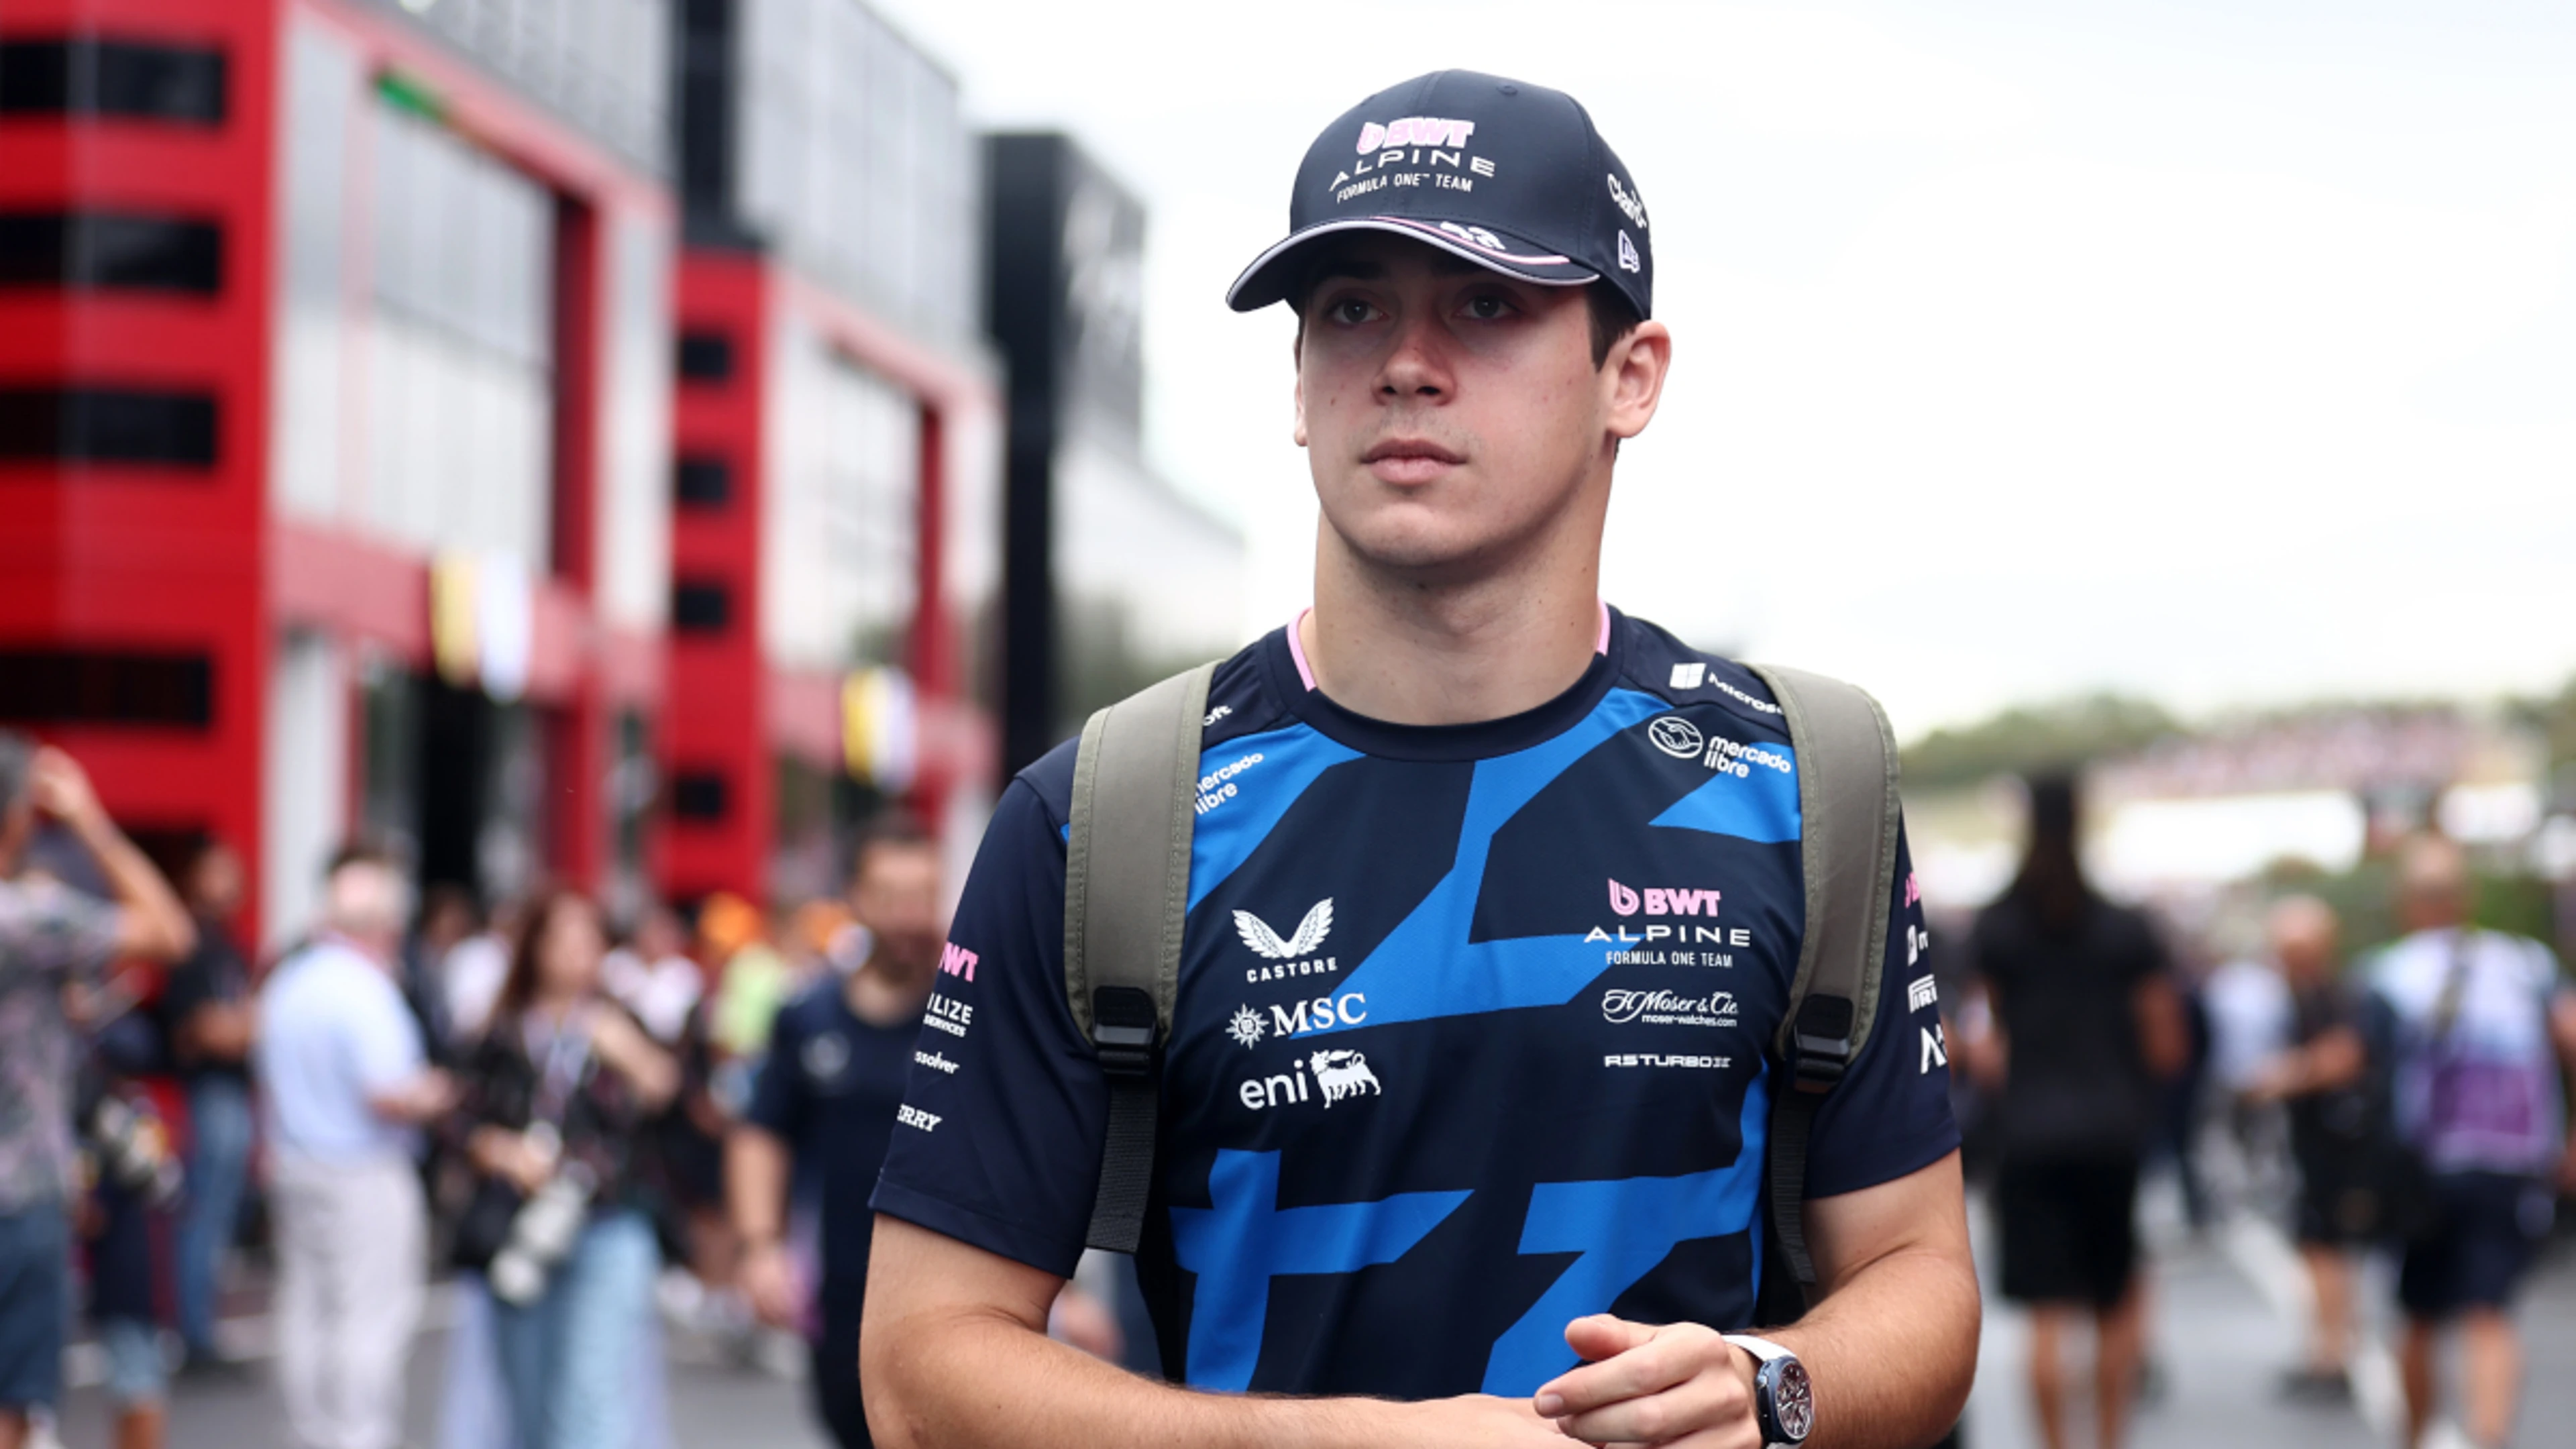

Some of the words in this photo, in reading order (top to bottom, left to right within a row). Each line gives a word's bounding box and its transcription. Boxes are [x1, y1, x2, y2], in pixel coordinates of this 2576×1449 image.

[1382, 117, 1475, 149] BWT
[1328, 148, 1496, 193] ALPINE
[1336, 174, 1388, 205] FORMULA
[1434, 173, 1474, 193] TEAM
[1703, 749, 1751, 779] libre
[1710, 735, 1792, 774] mercado
[1195, 782, 1238, 816] libre
[1643, 888, 1722, 918] BWT
[1583, 924, 1751, 948] ALPINE
[938, 941, 979, 983] WT
[1246, 957, 1338, 984] CASTORE
[1605, 950, 1667, 965] FORMULA
[1671, 951, 1697, 966] ONE
[1701, 952, 1734, 969] TEAM
[1268, 992, 1368, 1038] MSC
[1697, 997, 1710, 1013] &
[1239, 1059, 1309, 1110] eni
